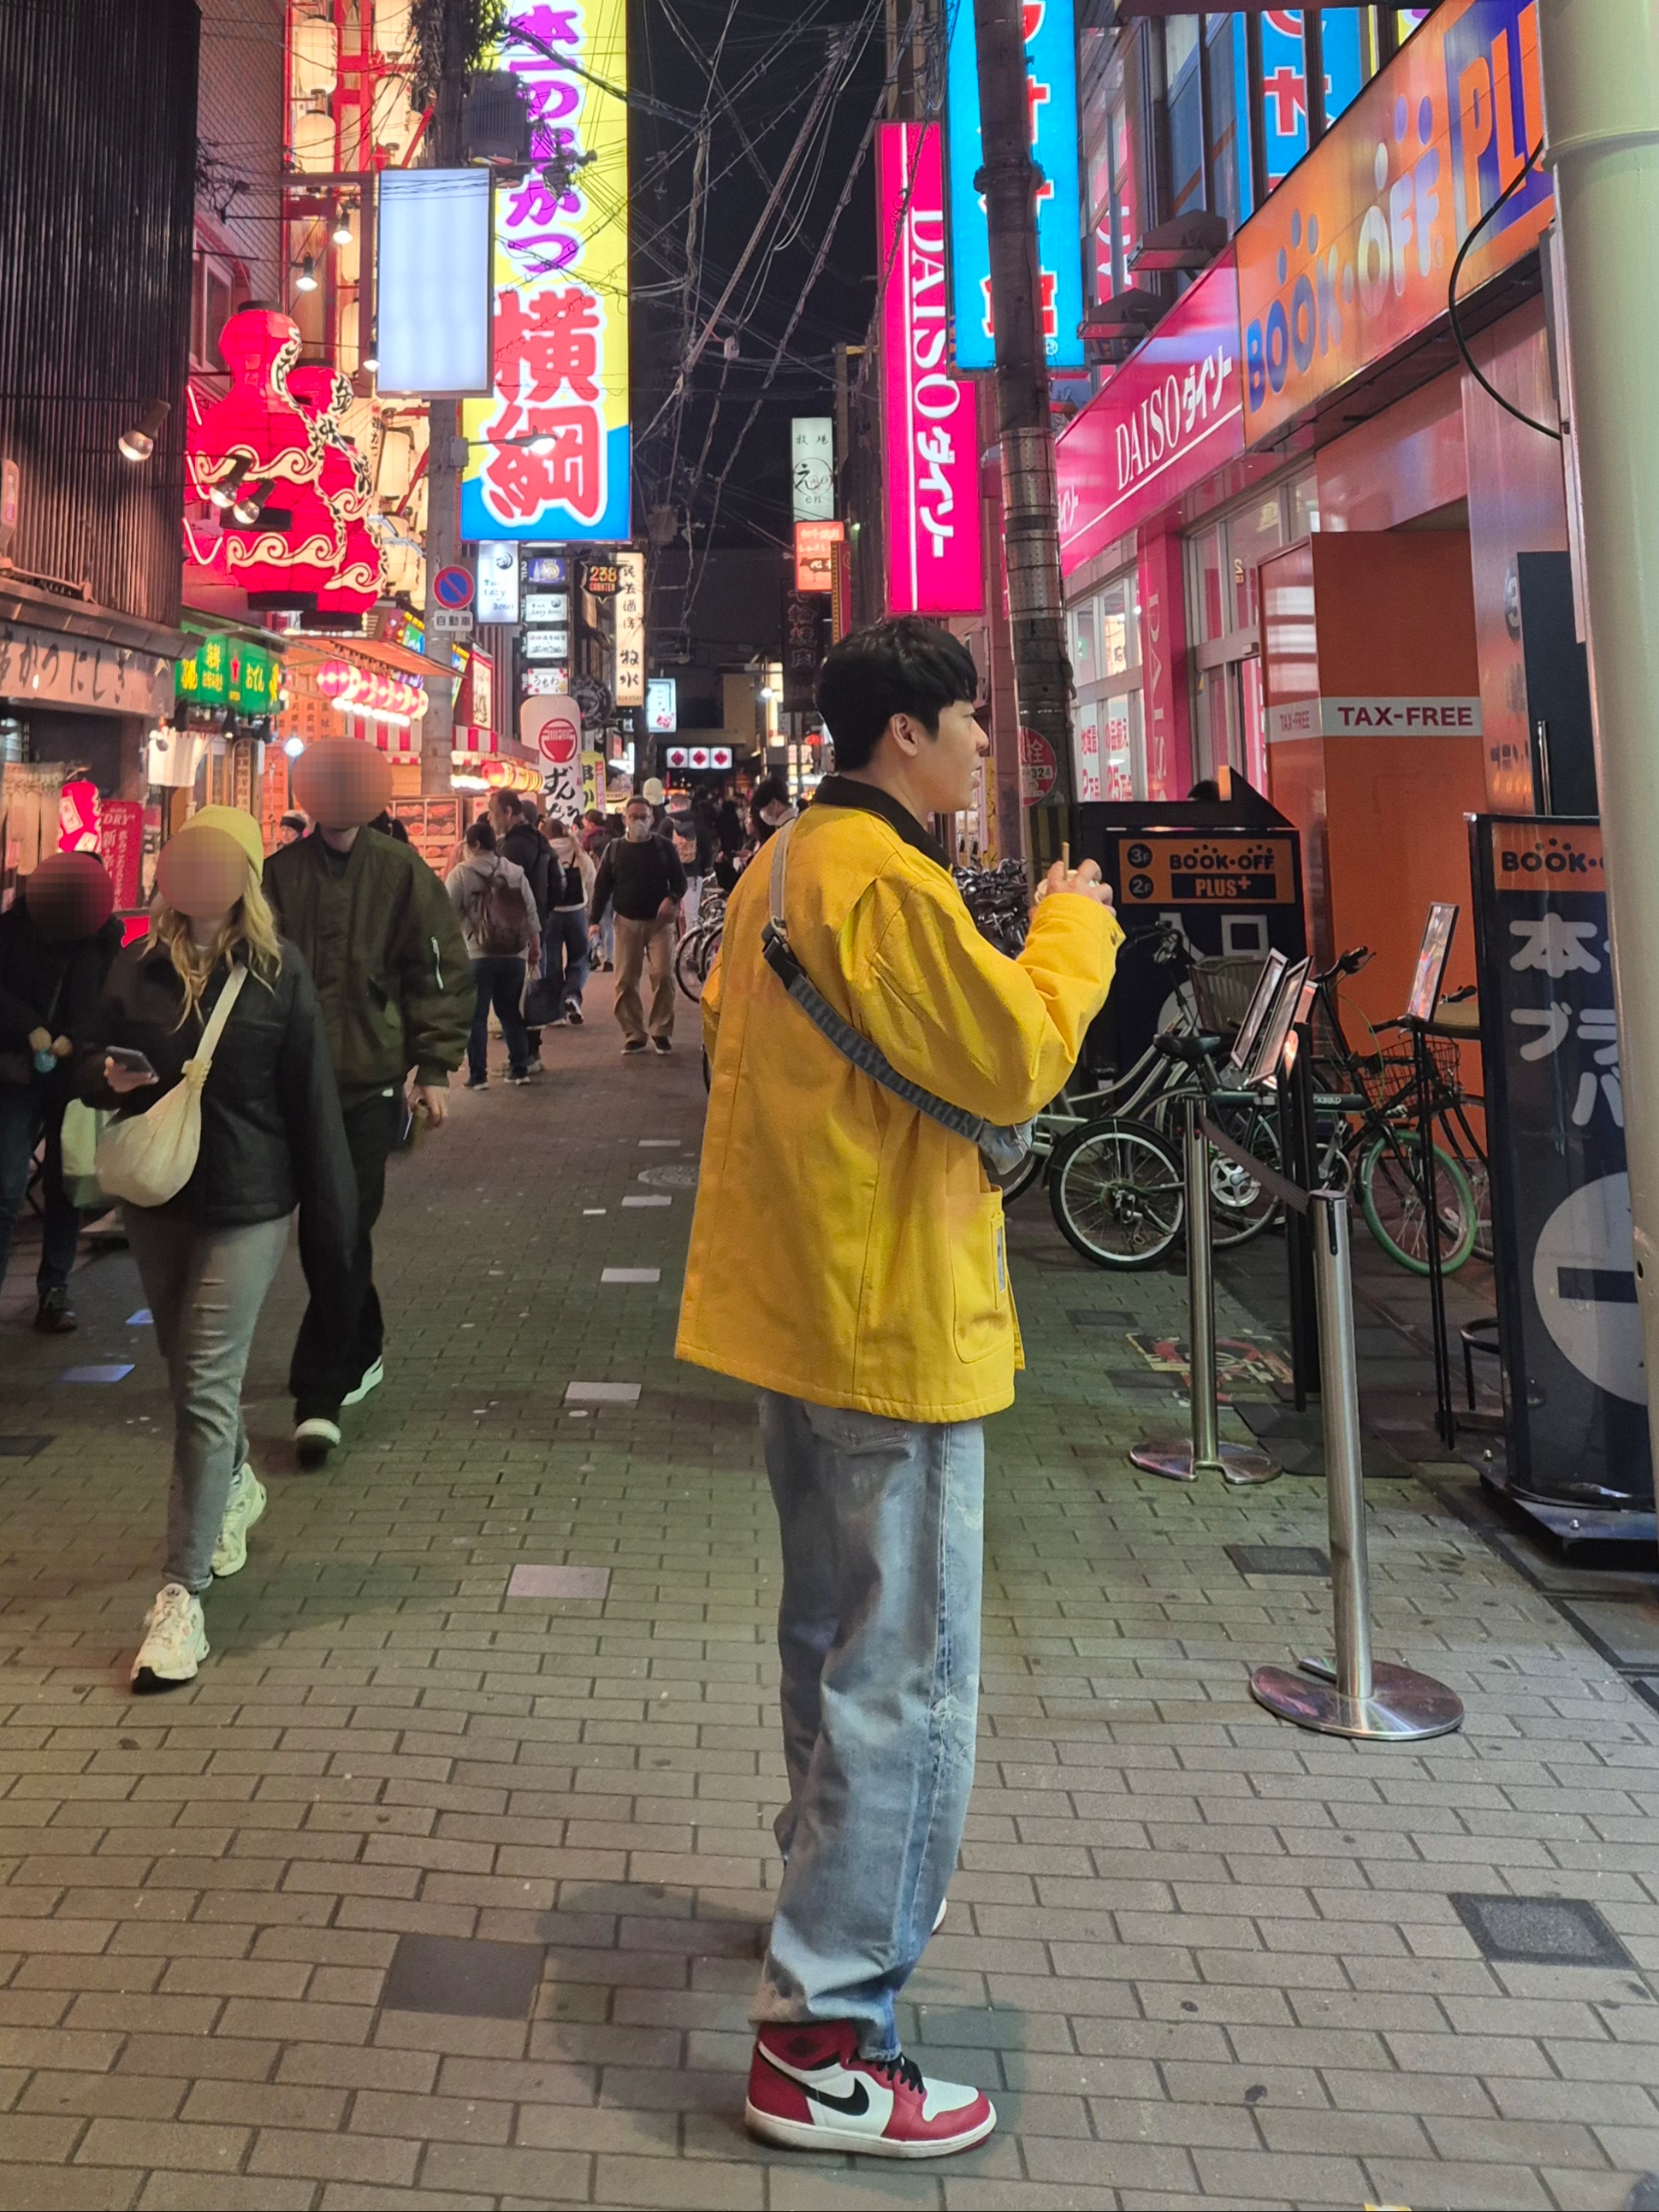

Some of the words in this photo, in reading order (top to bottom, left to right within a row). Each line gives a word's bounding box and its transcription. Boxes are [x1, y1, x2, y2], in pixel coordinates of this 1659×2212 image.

[911, 206, 960, 418] DAISO
[1116, 374, 1180, 491] DAISO
[1183, 345, 1232, 434] ダイソー
[917, 426, 956, 558] ダイソー
[1058, 484, 1079, 533] イソー
[590, 566, 618, 582] 238
[436, 616, 471, 626] 自動車
[1338, 707, 1473, 727] TAX-FREE
[1129, 848, 1151, 863] 3F
[1131, 879, 1152, 894] 2F
[1509, 912, 1610, 979] 本
